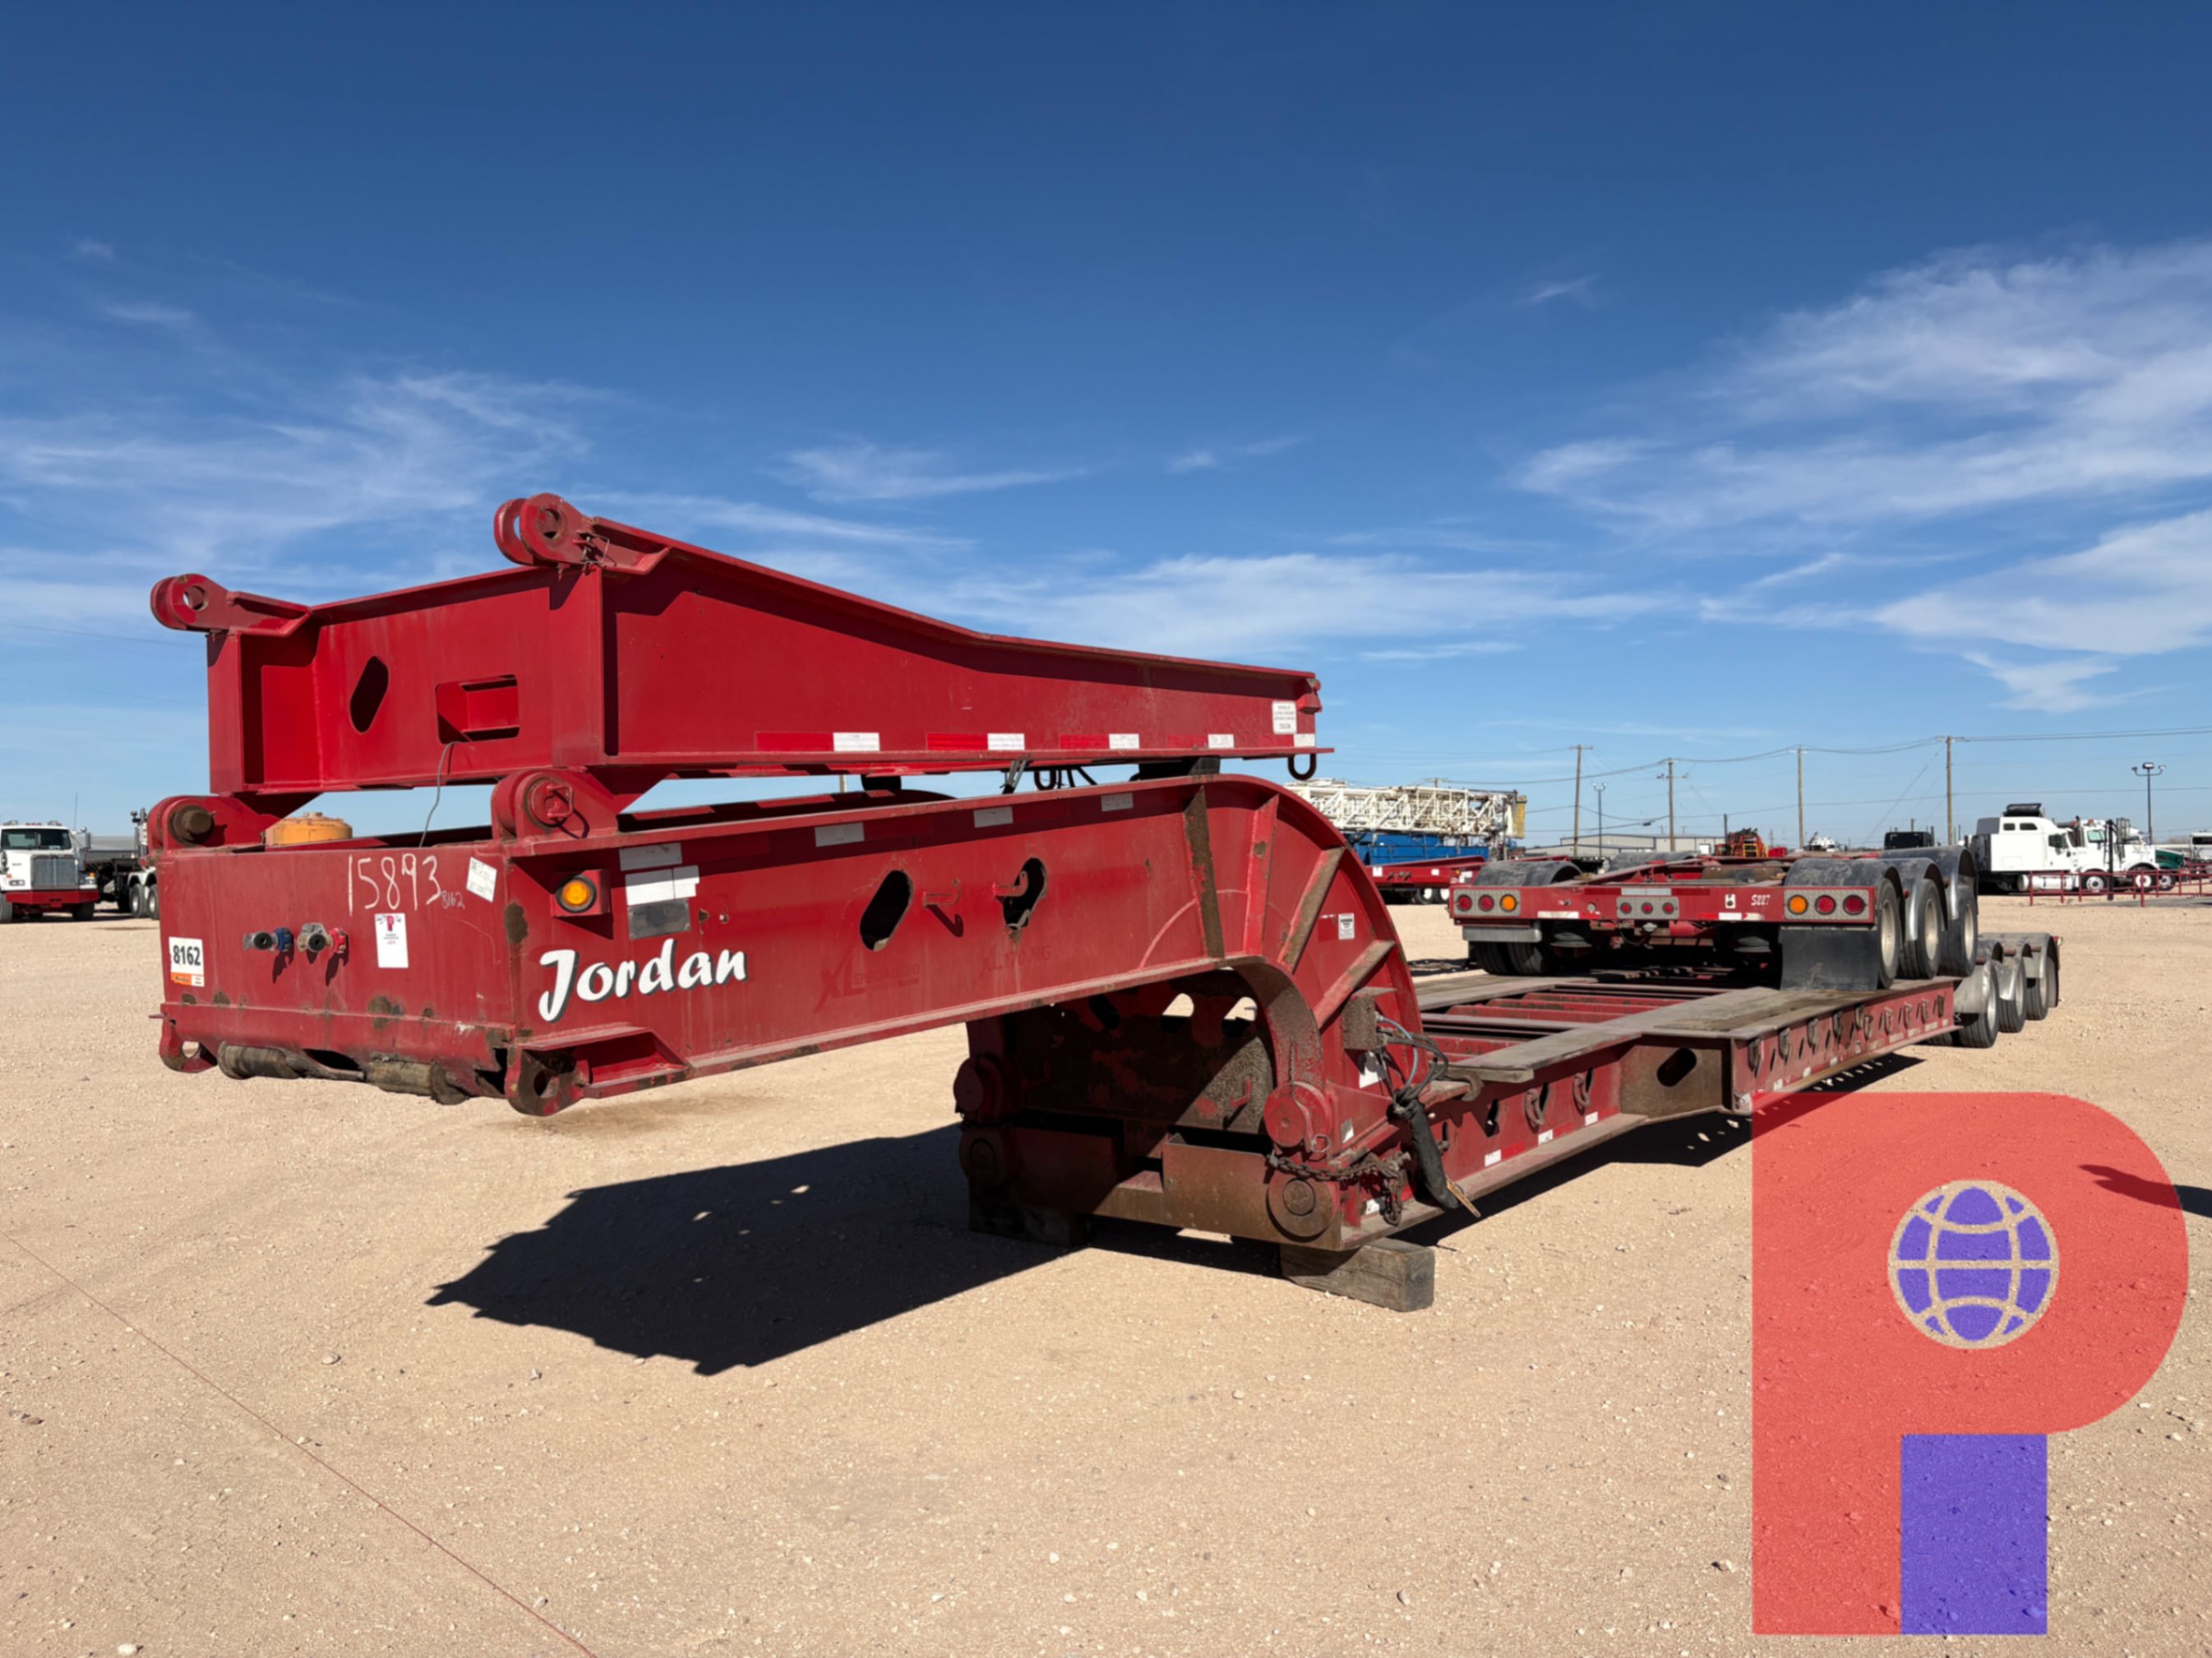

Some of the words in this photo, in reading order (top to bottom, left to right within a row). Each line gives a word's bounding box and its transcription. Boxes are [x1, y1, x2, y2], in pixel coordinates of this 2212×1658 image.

[349, 853, 441, 917] 15893
[173, 944, 201, 966] 8162
[538, 938, 748, 1023] Jordan
